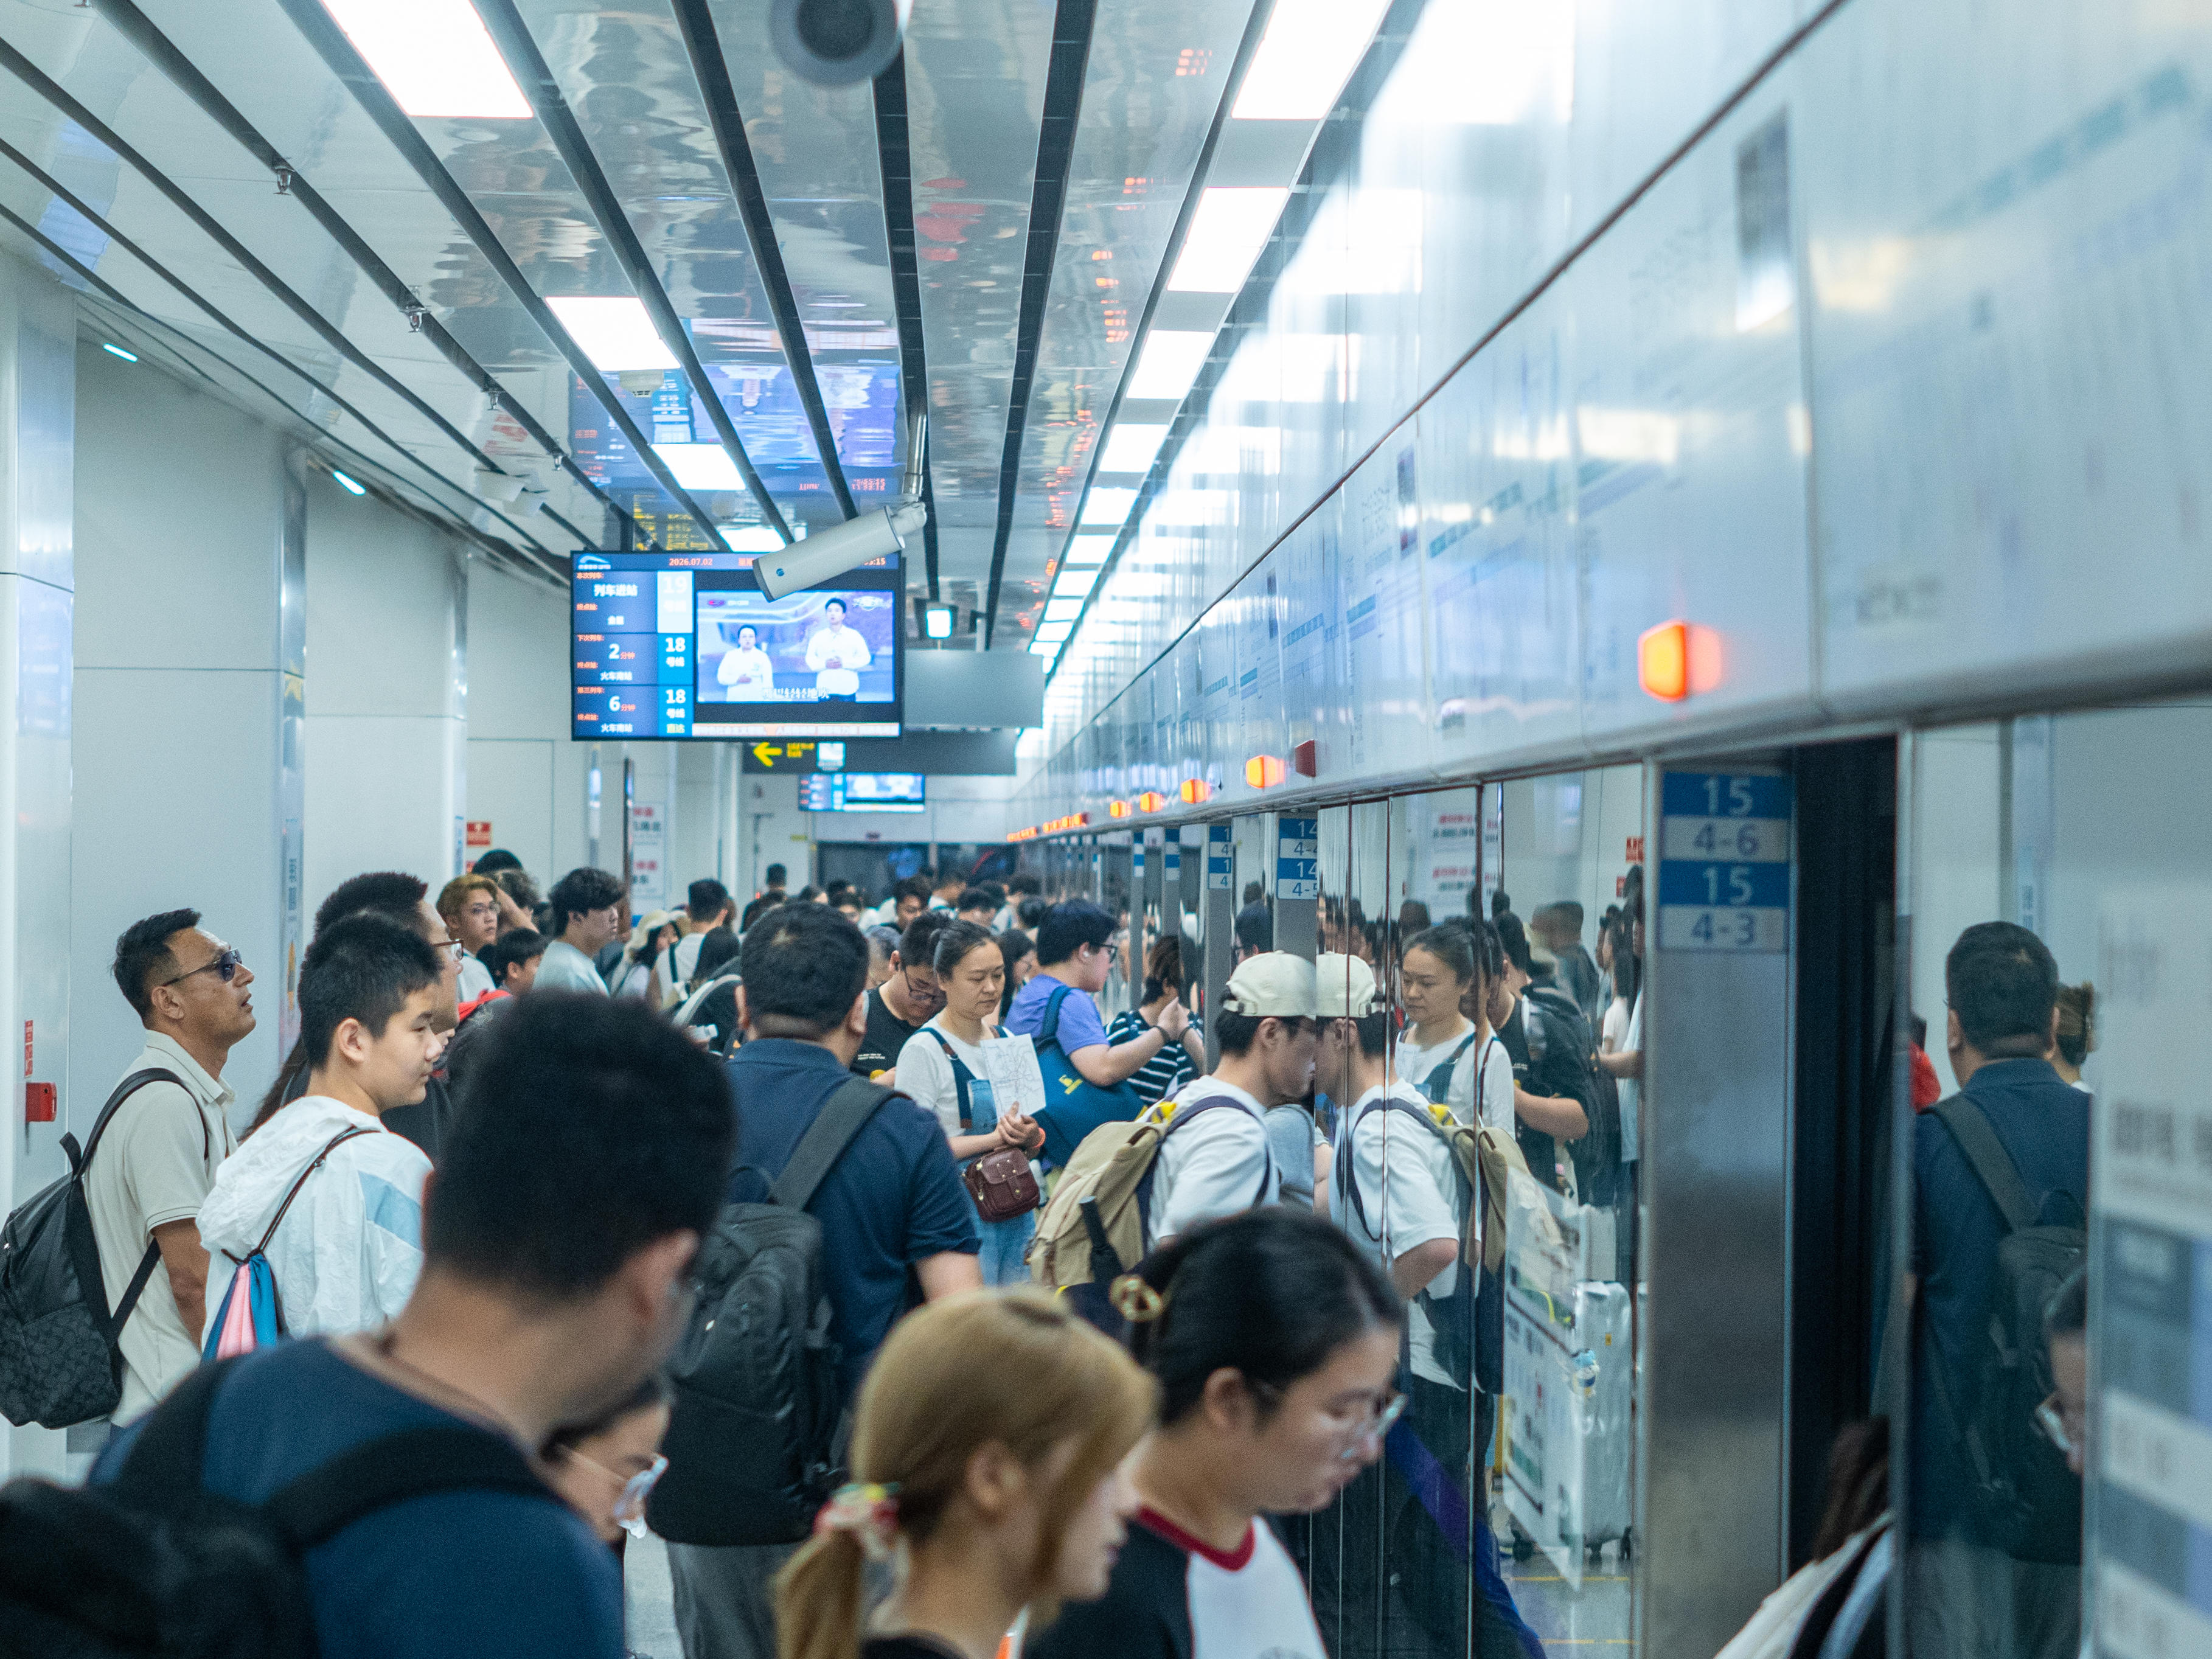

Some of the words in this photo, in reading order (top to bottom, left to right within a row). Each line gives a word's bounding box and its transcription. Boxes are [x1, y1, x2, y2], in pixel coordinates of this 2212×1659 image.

[593, 583, 638, 597] 列车进站
[663, 576, 687, 594] 19
[665, 637, 686, 652] 18
[666, 689, 686, 704] 18
[1705, 777, 1753, 816] 15
[1693, 824, 1758, 855] 4-6
[1704, 867, 1753, 905] 15
[1692, 913, 1756, 945] 4-3
